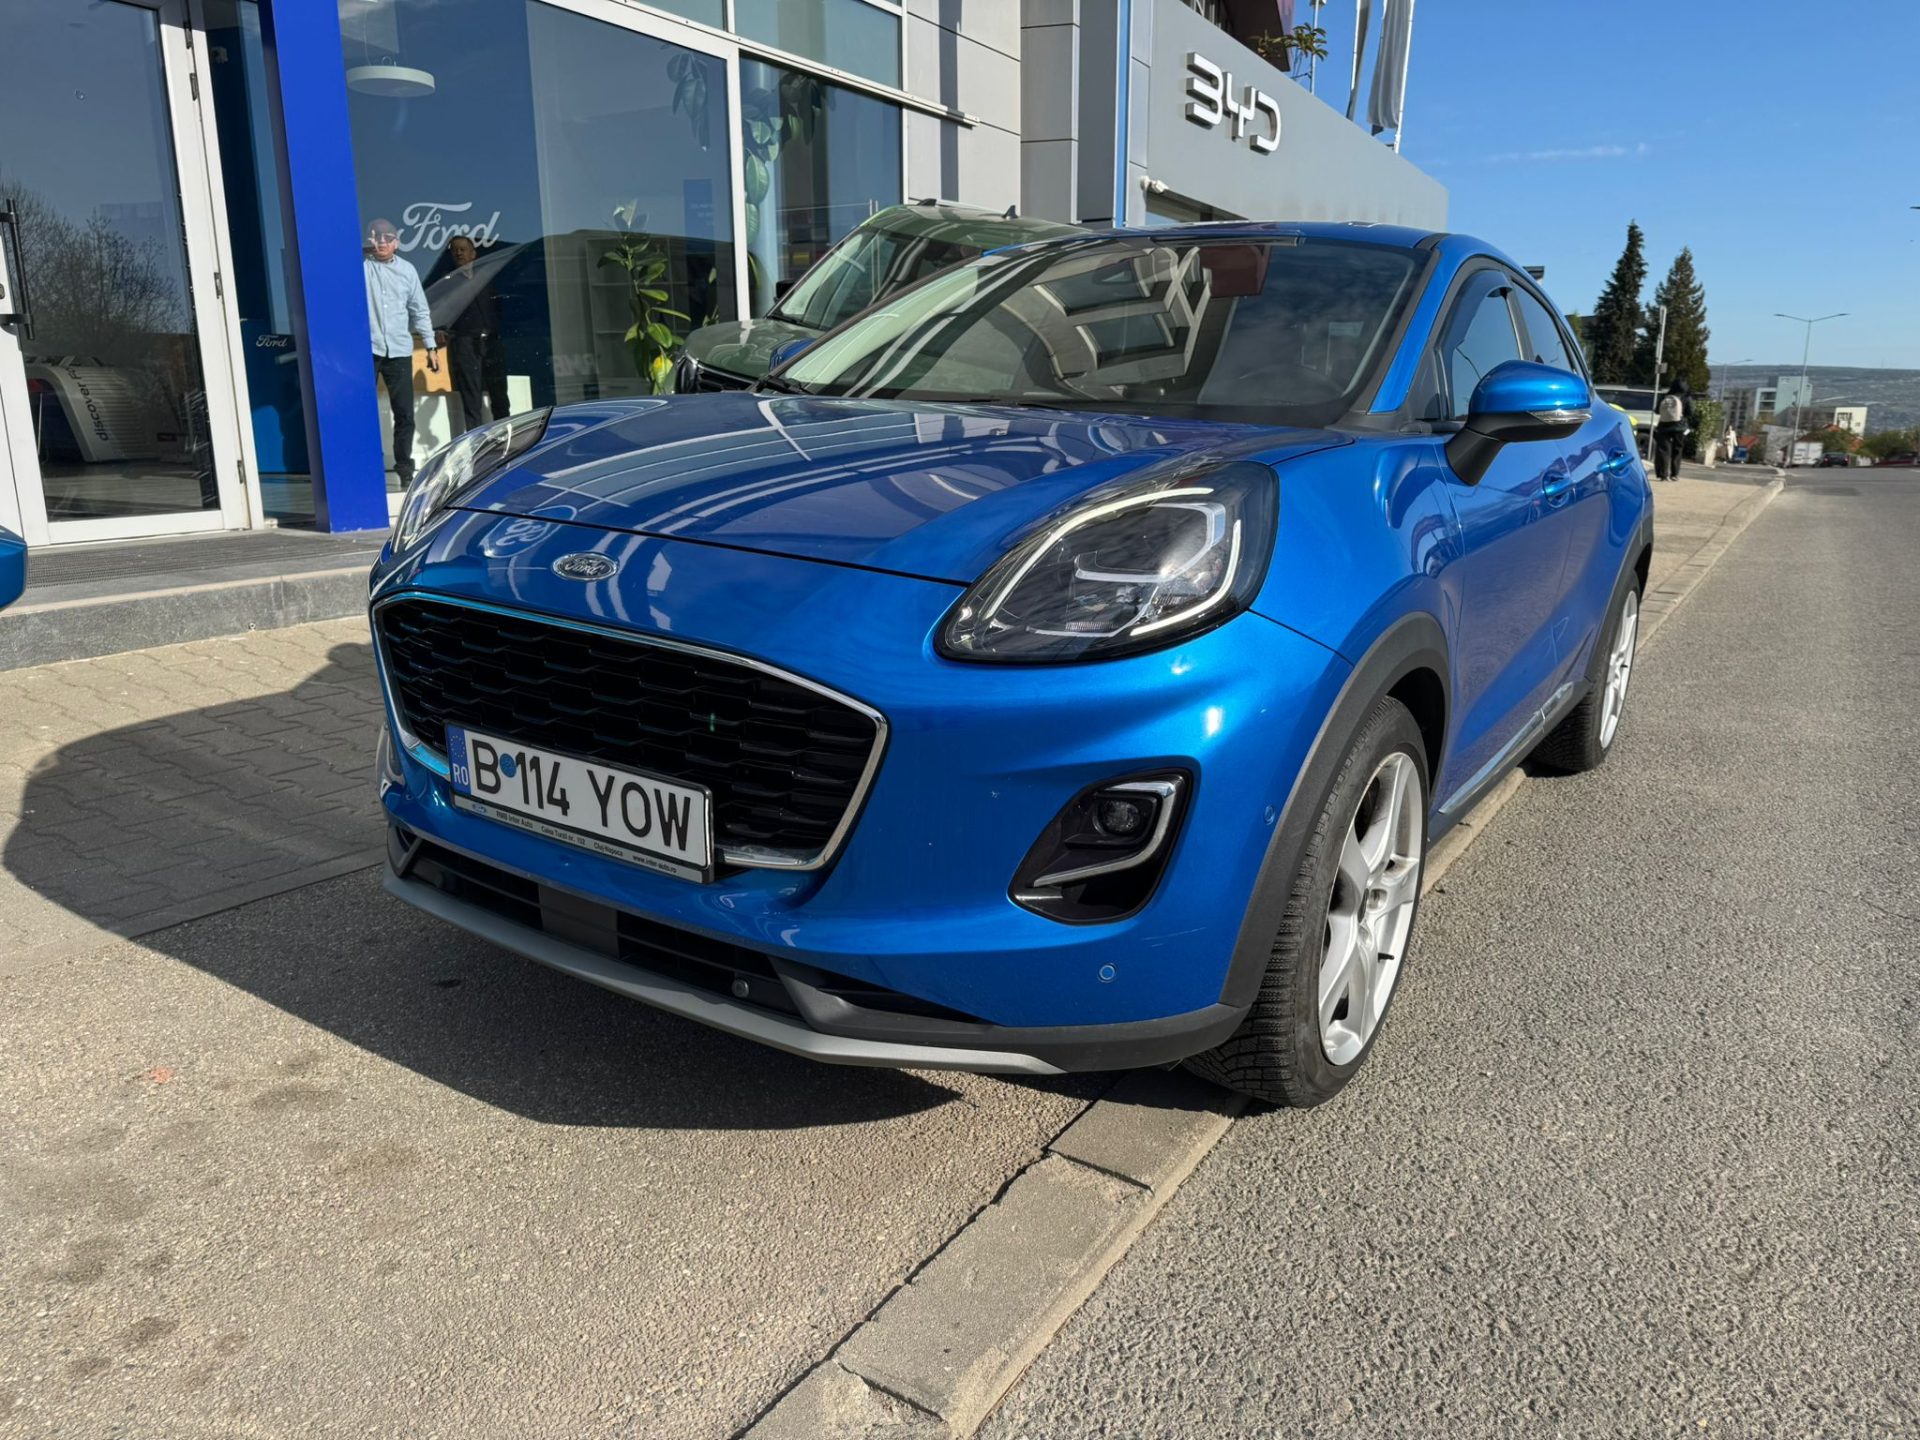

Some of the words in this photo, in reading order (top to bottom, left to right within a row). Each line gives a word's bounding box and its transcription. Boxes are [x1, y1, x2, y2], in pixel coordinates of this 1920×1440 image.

[1185, 52, 1281, 153] BYD
[397, 201, 501, 252] Ford
[255, 334, 288, 347] Ford
[77, 382, 109, 441] discover
[564, 558, 606, 575] Ford
[452, 763, 469, 787] RO
[472, 739, 501, 795] B
[515, 751, 570, 816] 114
[586, 769, 691, 851] YOW
